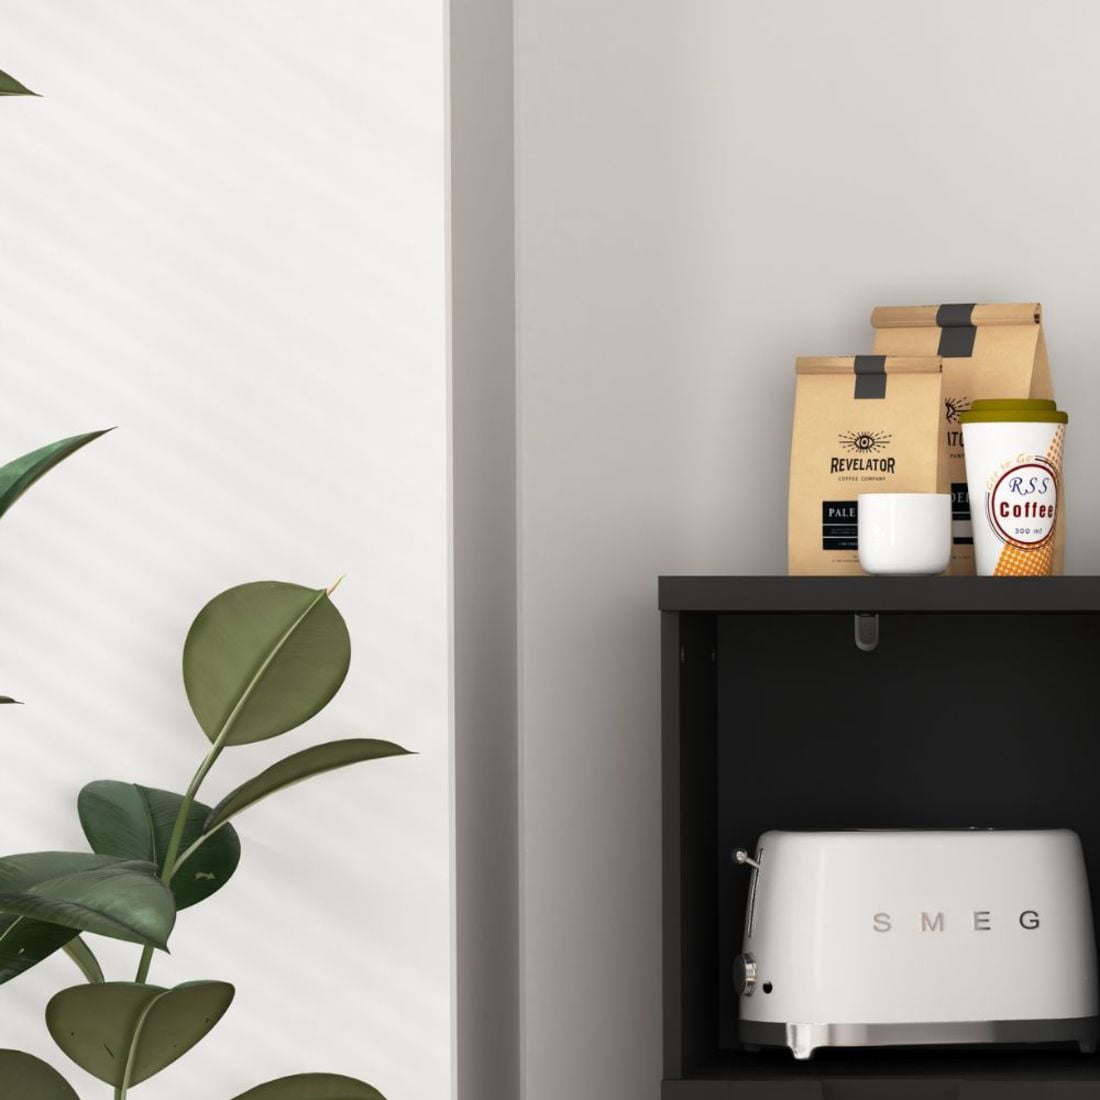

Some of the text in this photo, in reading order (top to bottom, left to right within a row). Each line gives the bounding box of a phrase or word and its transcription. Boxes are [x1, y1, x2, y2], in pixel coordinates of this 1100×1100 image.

[830, 456, 895, 474] REVELATOR
[1009, 477, 1049, 495] RSS
[828, 508, 856, 517] PALE
[1000, 502, 1054, 518] Coffee
[872, 910, 1040, 933] SMEG
